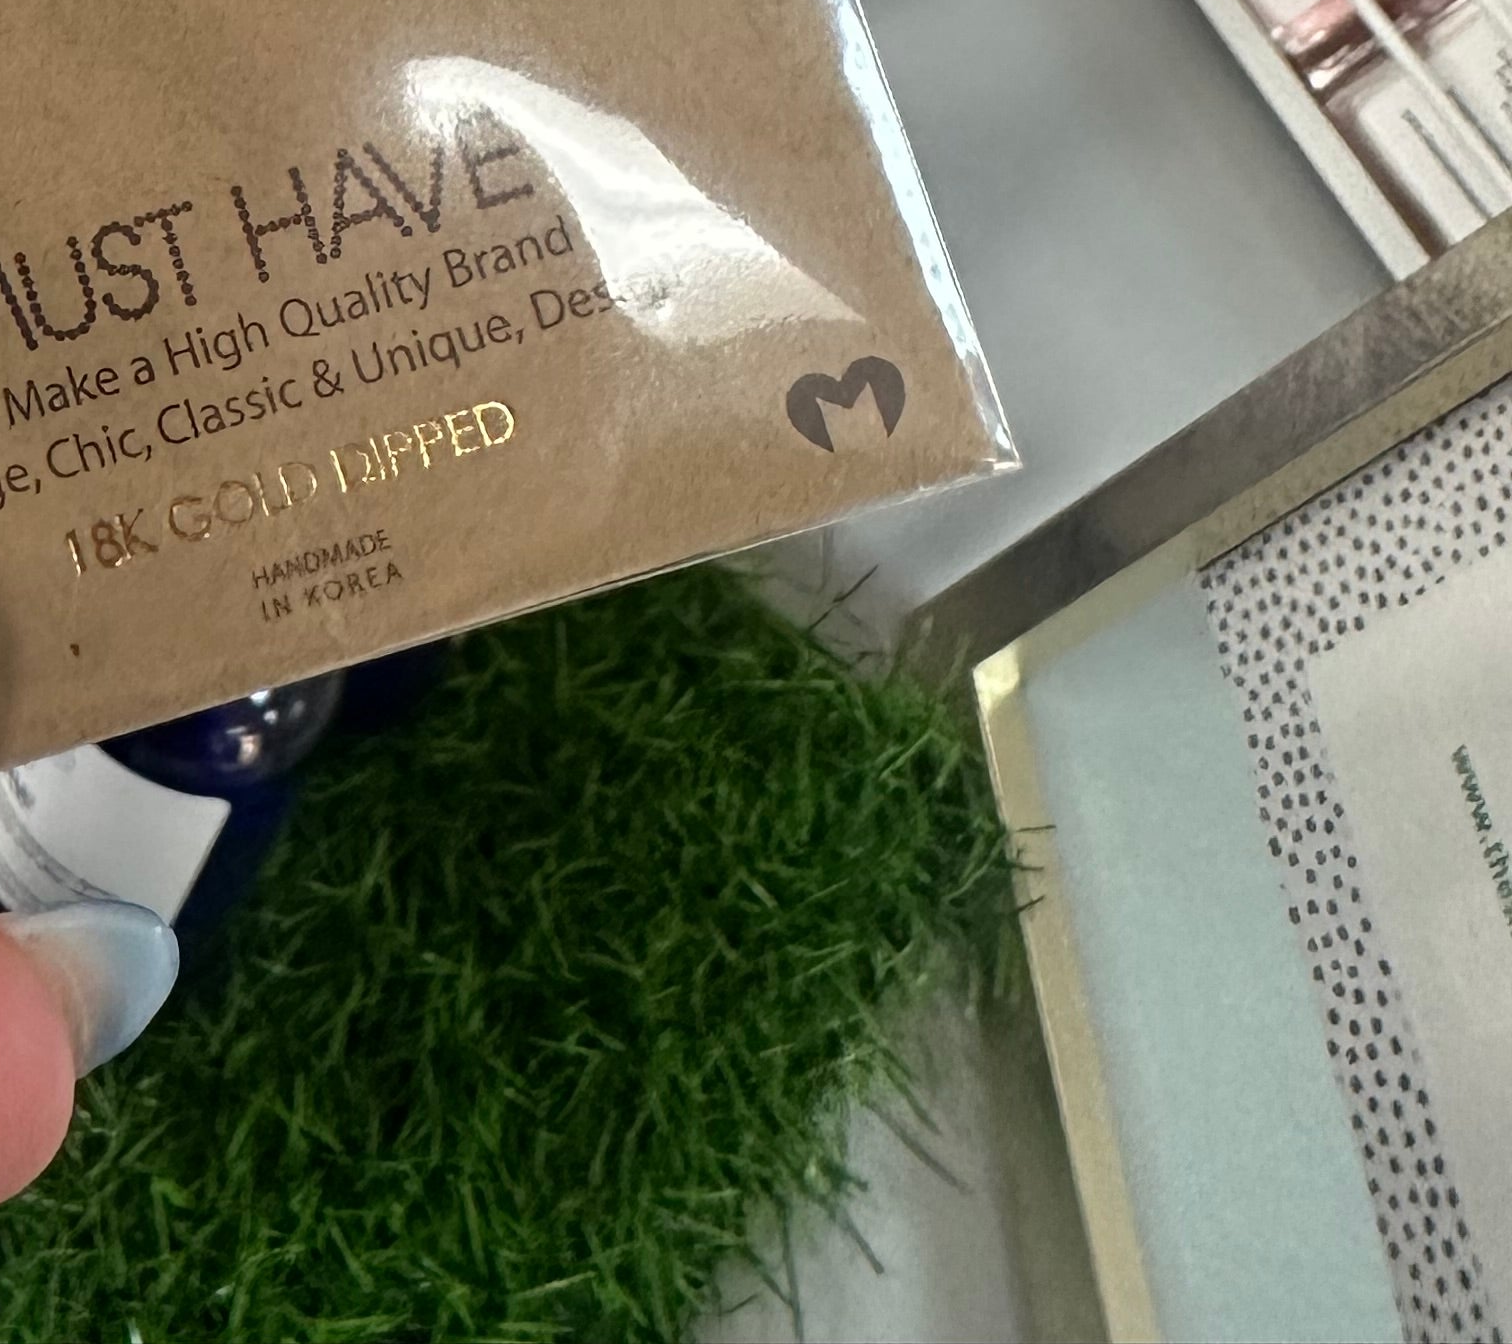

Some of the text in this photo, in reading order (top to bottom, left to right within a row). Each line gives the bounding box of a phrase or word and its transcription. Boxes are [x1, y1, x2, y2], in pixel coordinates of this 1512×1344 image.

[230, 107, 536, 283] HAVE
[2, 365, 120, 430] Make
[133, 356, 155, 386] a
[163, 312, 270, 376] High
[278, 267, 432, 337] Quality
[442, 215, 575, 289] Brand
[45, 425, 153, 480] Chic,
[156, 376, 304, 445] Classic
[312, 358, 345, 399] &
[351, 314, 526, 385] Unique,
[64, 400, 517, 578] 18K GOLD DIPPED
[251, 528, 395, 590] HANDMADE
[259, 561, 405, 624] IN KOREA
